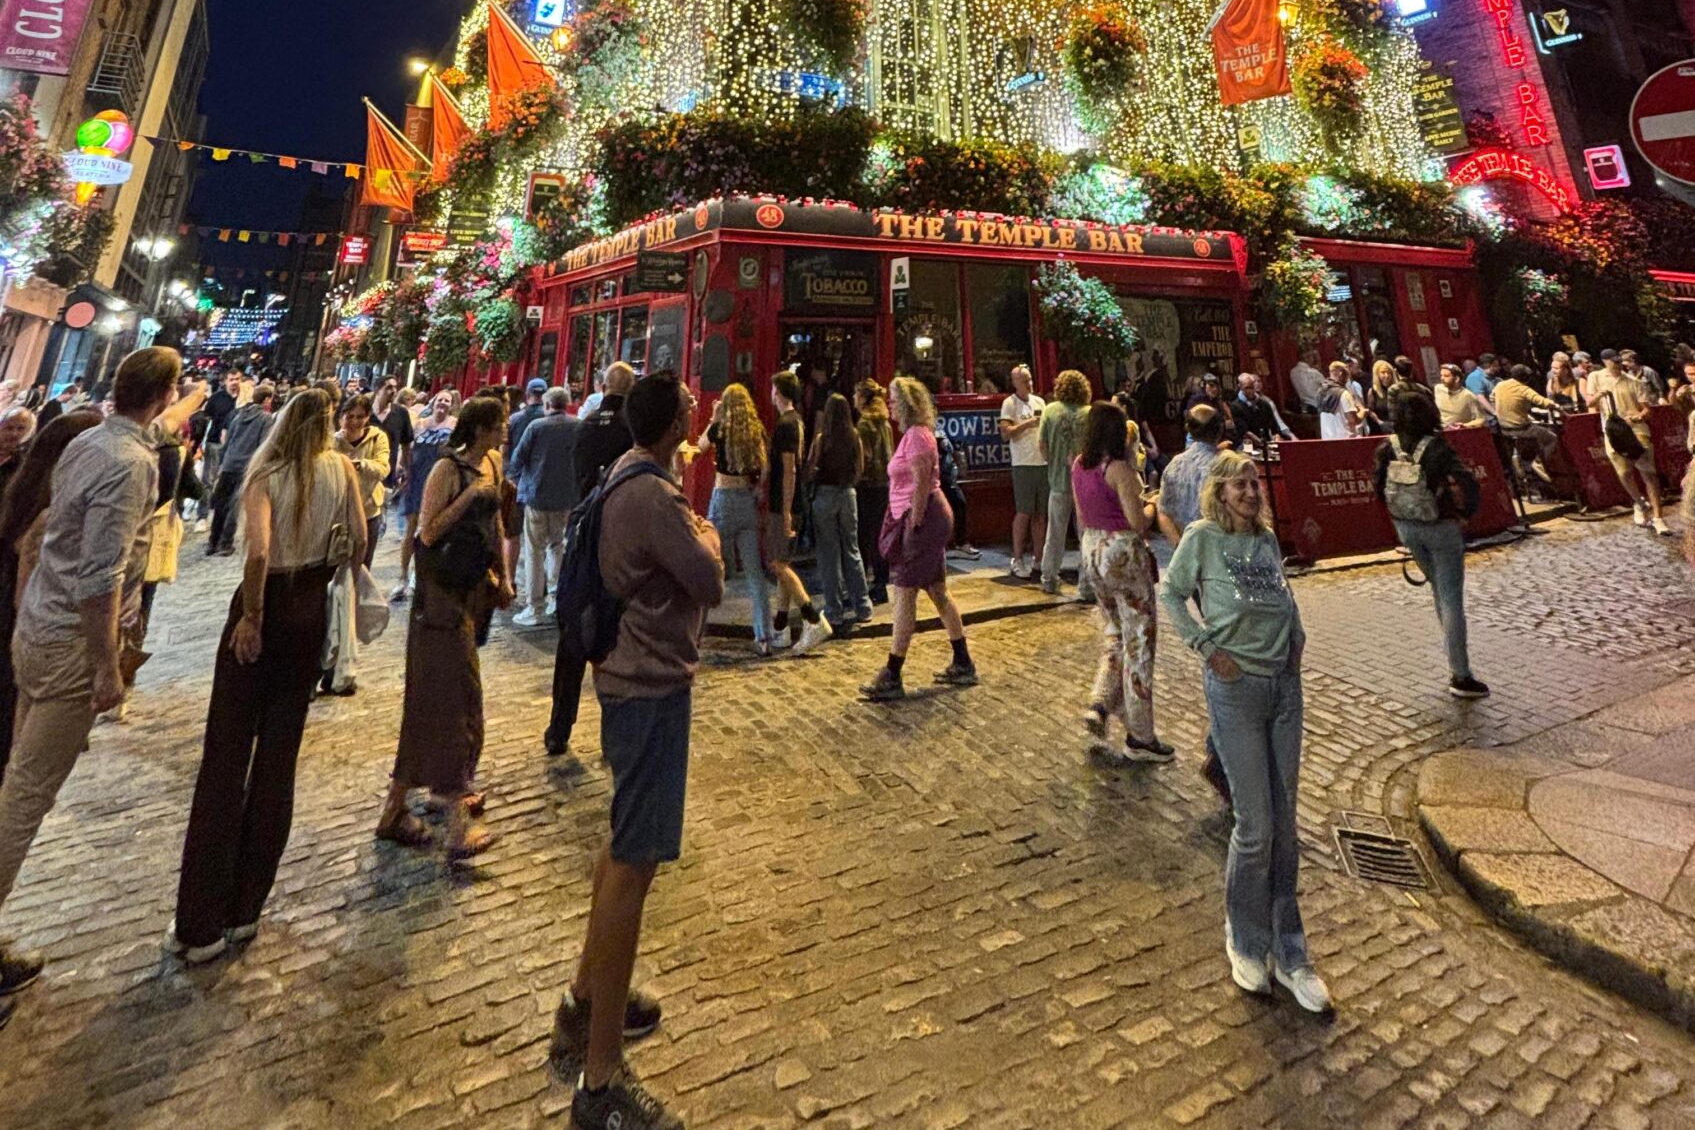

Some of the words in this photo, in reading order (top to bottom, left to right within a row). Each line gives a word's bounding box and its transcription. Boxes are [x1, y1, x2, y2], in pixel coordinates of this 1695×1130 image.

[6, 46, 34, 57] CLOUD
[36, 51, 58, 61] NINE
[1235, 43, 1259, 57] THE
[1220, 48, 1279, 73] TEMPLE
[1235, 67, 1264, 83] BAR
[1411, 78, 1454, 96] TEMPLE
[1422, 90, 1446, 102] BAR
[1518, 84, 1547, 146] BAR
[1440, 129, 1461, 138] MUSIC
[101, 160, 123, 173] NINE
[1537, 170, 1570, 214] BAR
[761, 207, 778, 223] 48
[876, 213, 946, 241] THE
[956, 219, 1077, 249] TEMPLE
[1088, 230, 1144, 254] BAR
[566, 252, 588, 271] THE
[591, 231, 640, 264] TEMPLE
[645, 218, 677, 248] BAR
[801, 272, 868, 300] TOBACCO
[1211, 325, 1231, 341] THE
[1192, 341, 1234, 357] EMPEROR
[1334, 470, 1354, 479] THE
[1312, 480, 1357, 497] TEMPLE
[1358, 480, 1375, 494] BA
